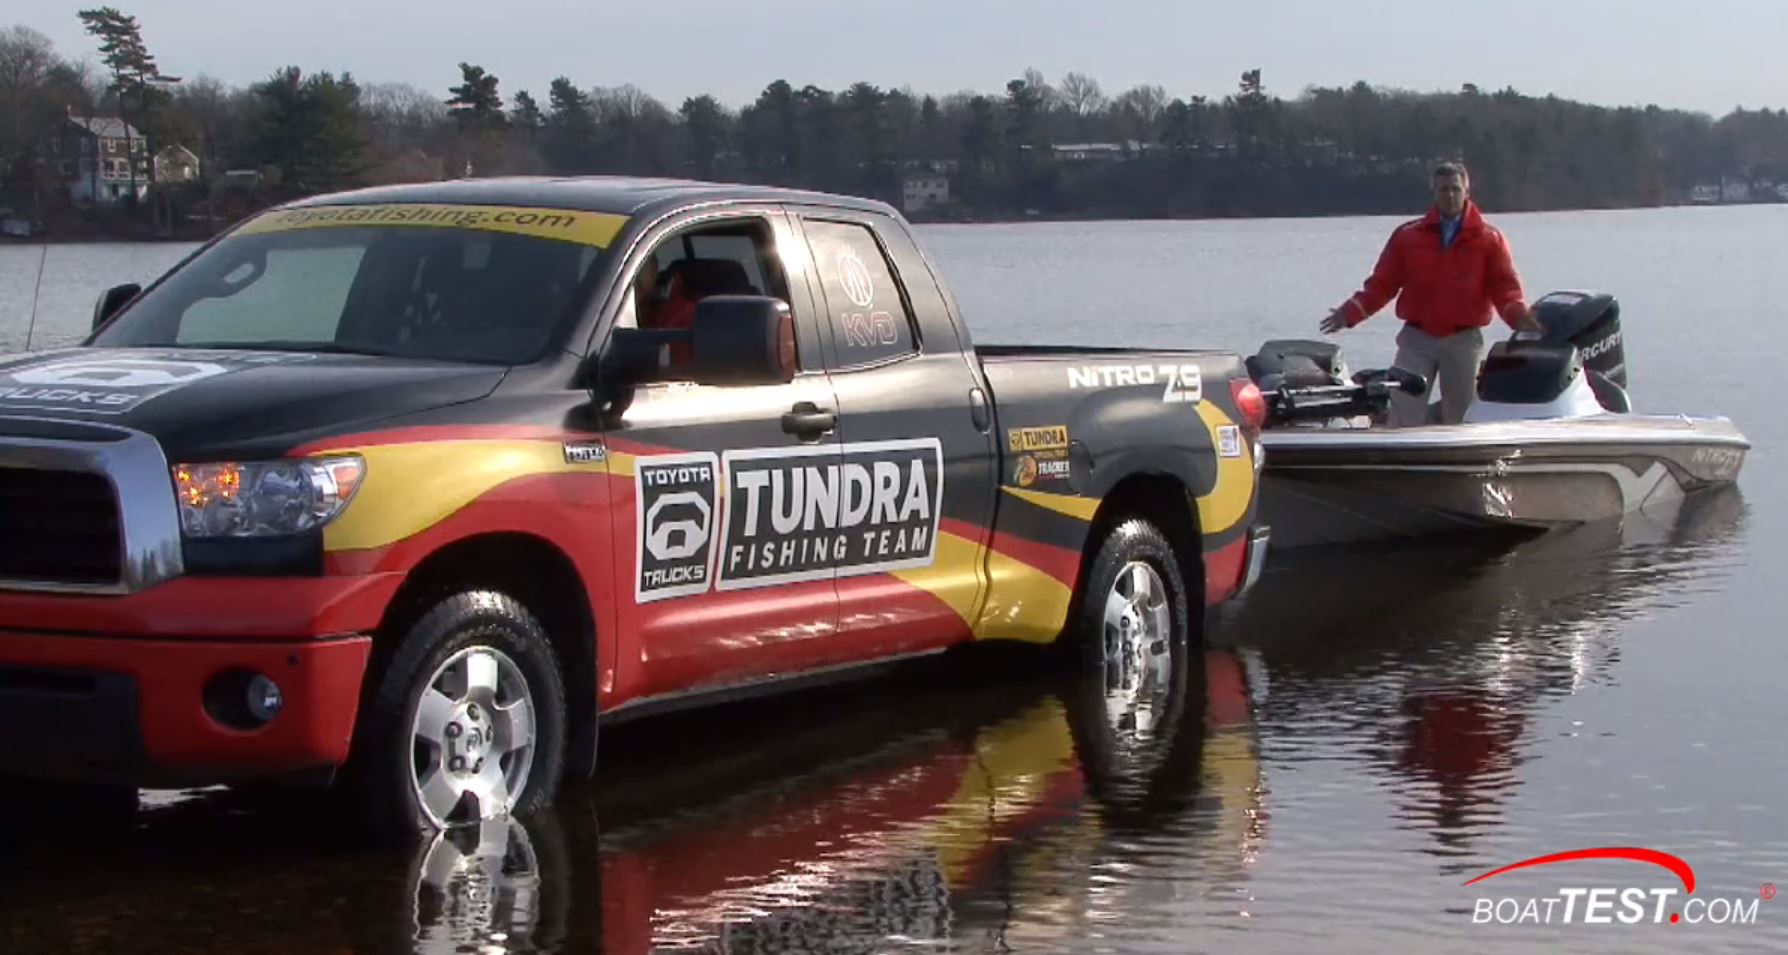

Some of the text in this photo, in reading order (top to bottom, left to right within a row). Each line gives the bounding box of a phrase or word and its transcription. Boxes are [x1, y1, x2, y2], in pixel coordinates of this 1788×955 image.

[841, 311, 898, 347] KVD
[1023, 429, 1066, 446] TUNDRA
[643, 466, 712, 486] TOYOTA
[1038, 461, 1070, 475] TRACKER
[736, 459, 931, 537] TUNDRA
[730, 526, 929, 572] FISHING TEAM
[643, 564, 706, 587] TRUCKS
